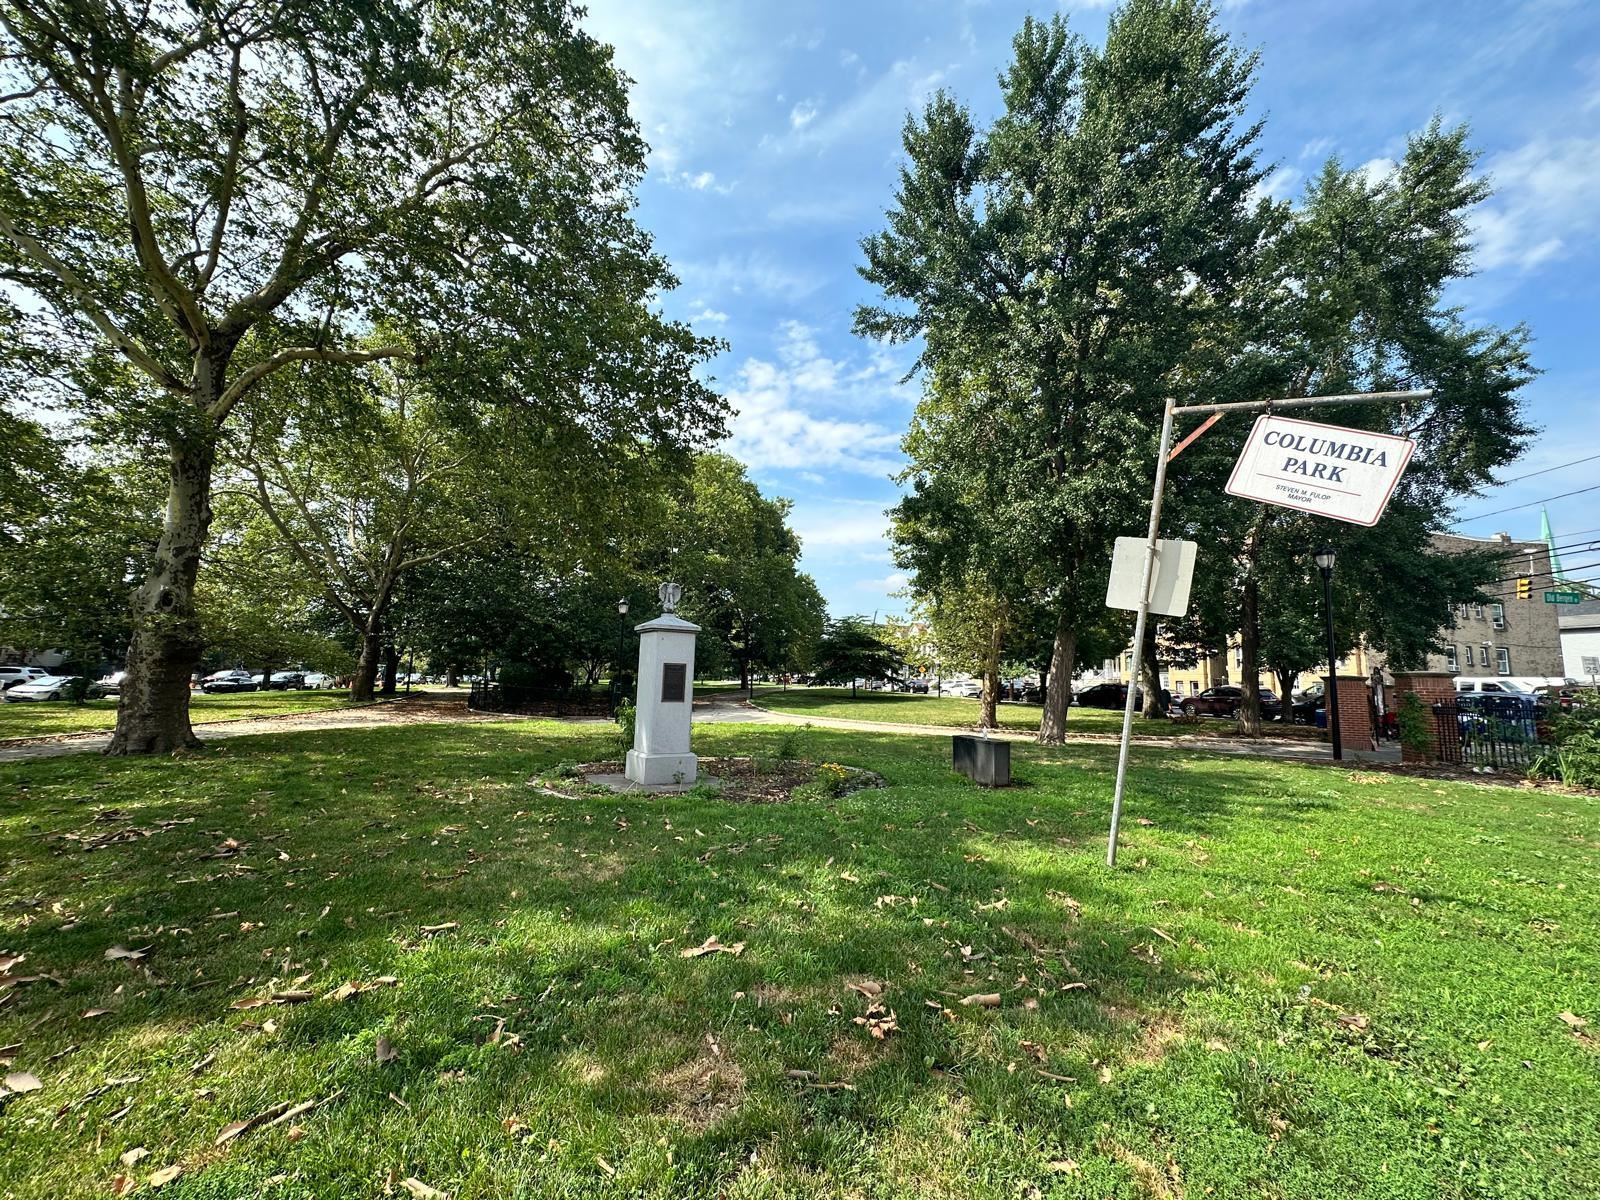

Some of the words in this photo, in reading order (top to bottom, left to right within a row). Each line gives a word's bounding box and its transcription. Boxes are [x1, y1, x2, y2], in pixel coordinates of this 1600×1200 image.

[1263, 431, 1388, 468] COLUMBIA
[1281, 456, 1348, 483] PARK
[1275, 484, 1300, 494] STEVEN
[1309, 491, 1332, 500] FULOP
[1287, 493, 1313, 503] MAYOR
[1585, 666, 1599, 674] 25
